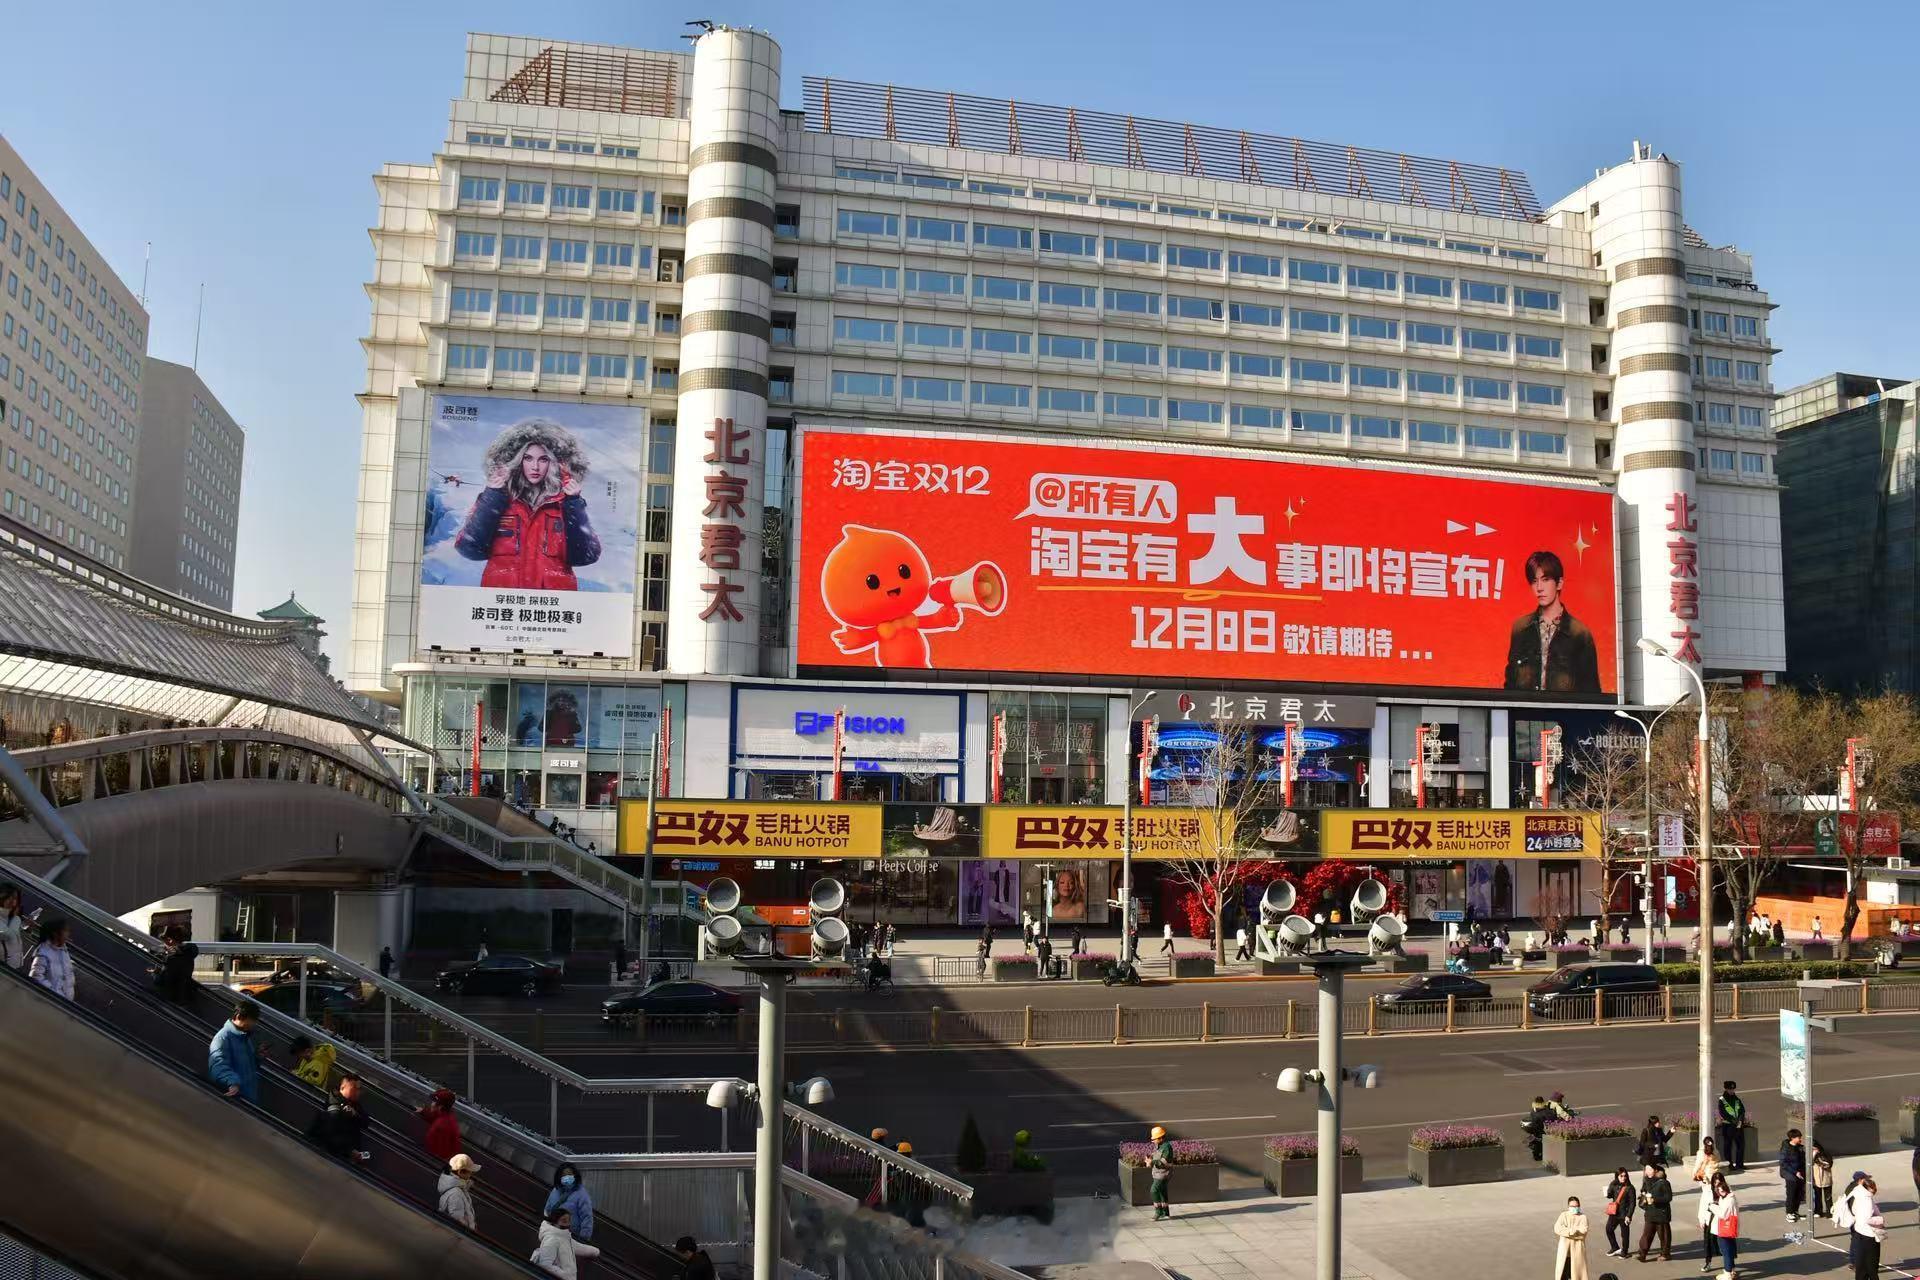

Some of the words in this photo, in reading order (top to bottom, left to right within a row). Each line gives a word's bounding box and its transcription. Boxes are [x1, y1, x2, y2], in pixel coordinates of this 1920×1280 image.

[831, 459, 991, 496] 淘宝双12
[1035, 477, 1171, 519] @所有人
[698, 417, 751, 622] 北京君太
[1030, 526, 1178, 583] 淘宝有
[1665, 491, 1701, 664] 北京君太
[471, 606, 514, 621] 波司登
[519, 608, 575, 624] 极地极寒
[495, 594, 526, 605] 穿极地
[528, 595, 560, 606] 探极致
[1130, 605, 1276, 654] 12月8日
[1209, 695, 1337, 723] 北京君太
[1596, 735, 1648, 749] HOLLISTER
[854, 760, 881, 771] FILA
[653, 810, 750, 846] 巴奴
[755, 813, 850, 836] 毛肚火锅
[1015, 815, 1110, 850] 巴奴
[1114, 817, 1200, 838] 毛肚火锅
[1351, 817, 1433, 851] 巴奴
[1437, 819, 1511, 839] 毛肚火锅
[1527, 819, 1583, 832] 北京君太B1
[755, 836, 792, 848] BANU
[796, 837, 850, 848] HOTPOT
[1151, 840, 1200, 851] HOTPOT
[1437, 840, 1466, 850] BANU
[1469, 840, 1511, 851] HOTPOT
